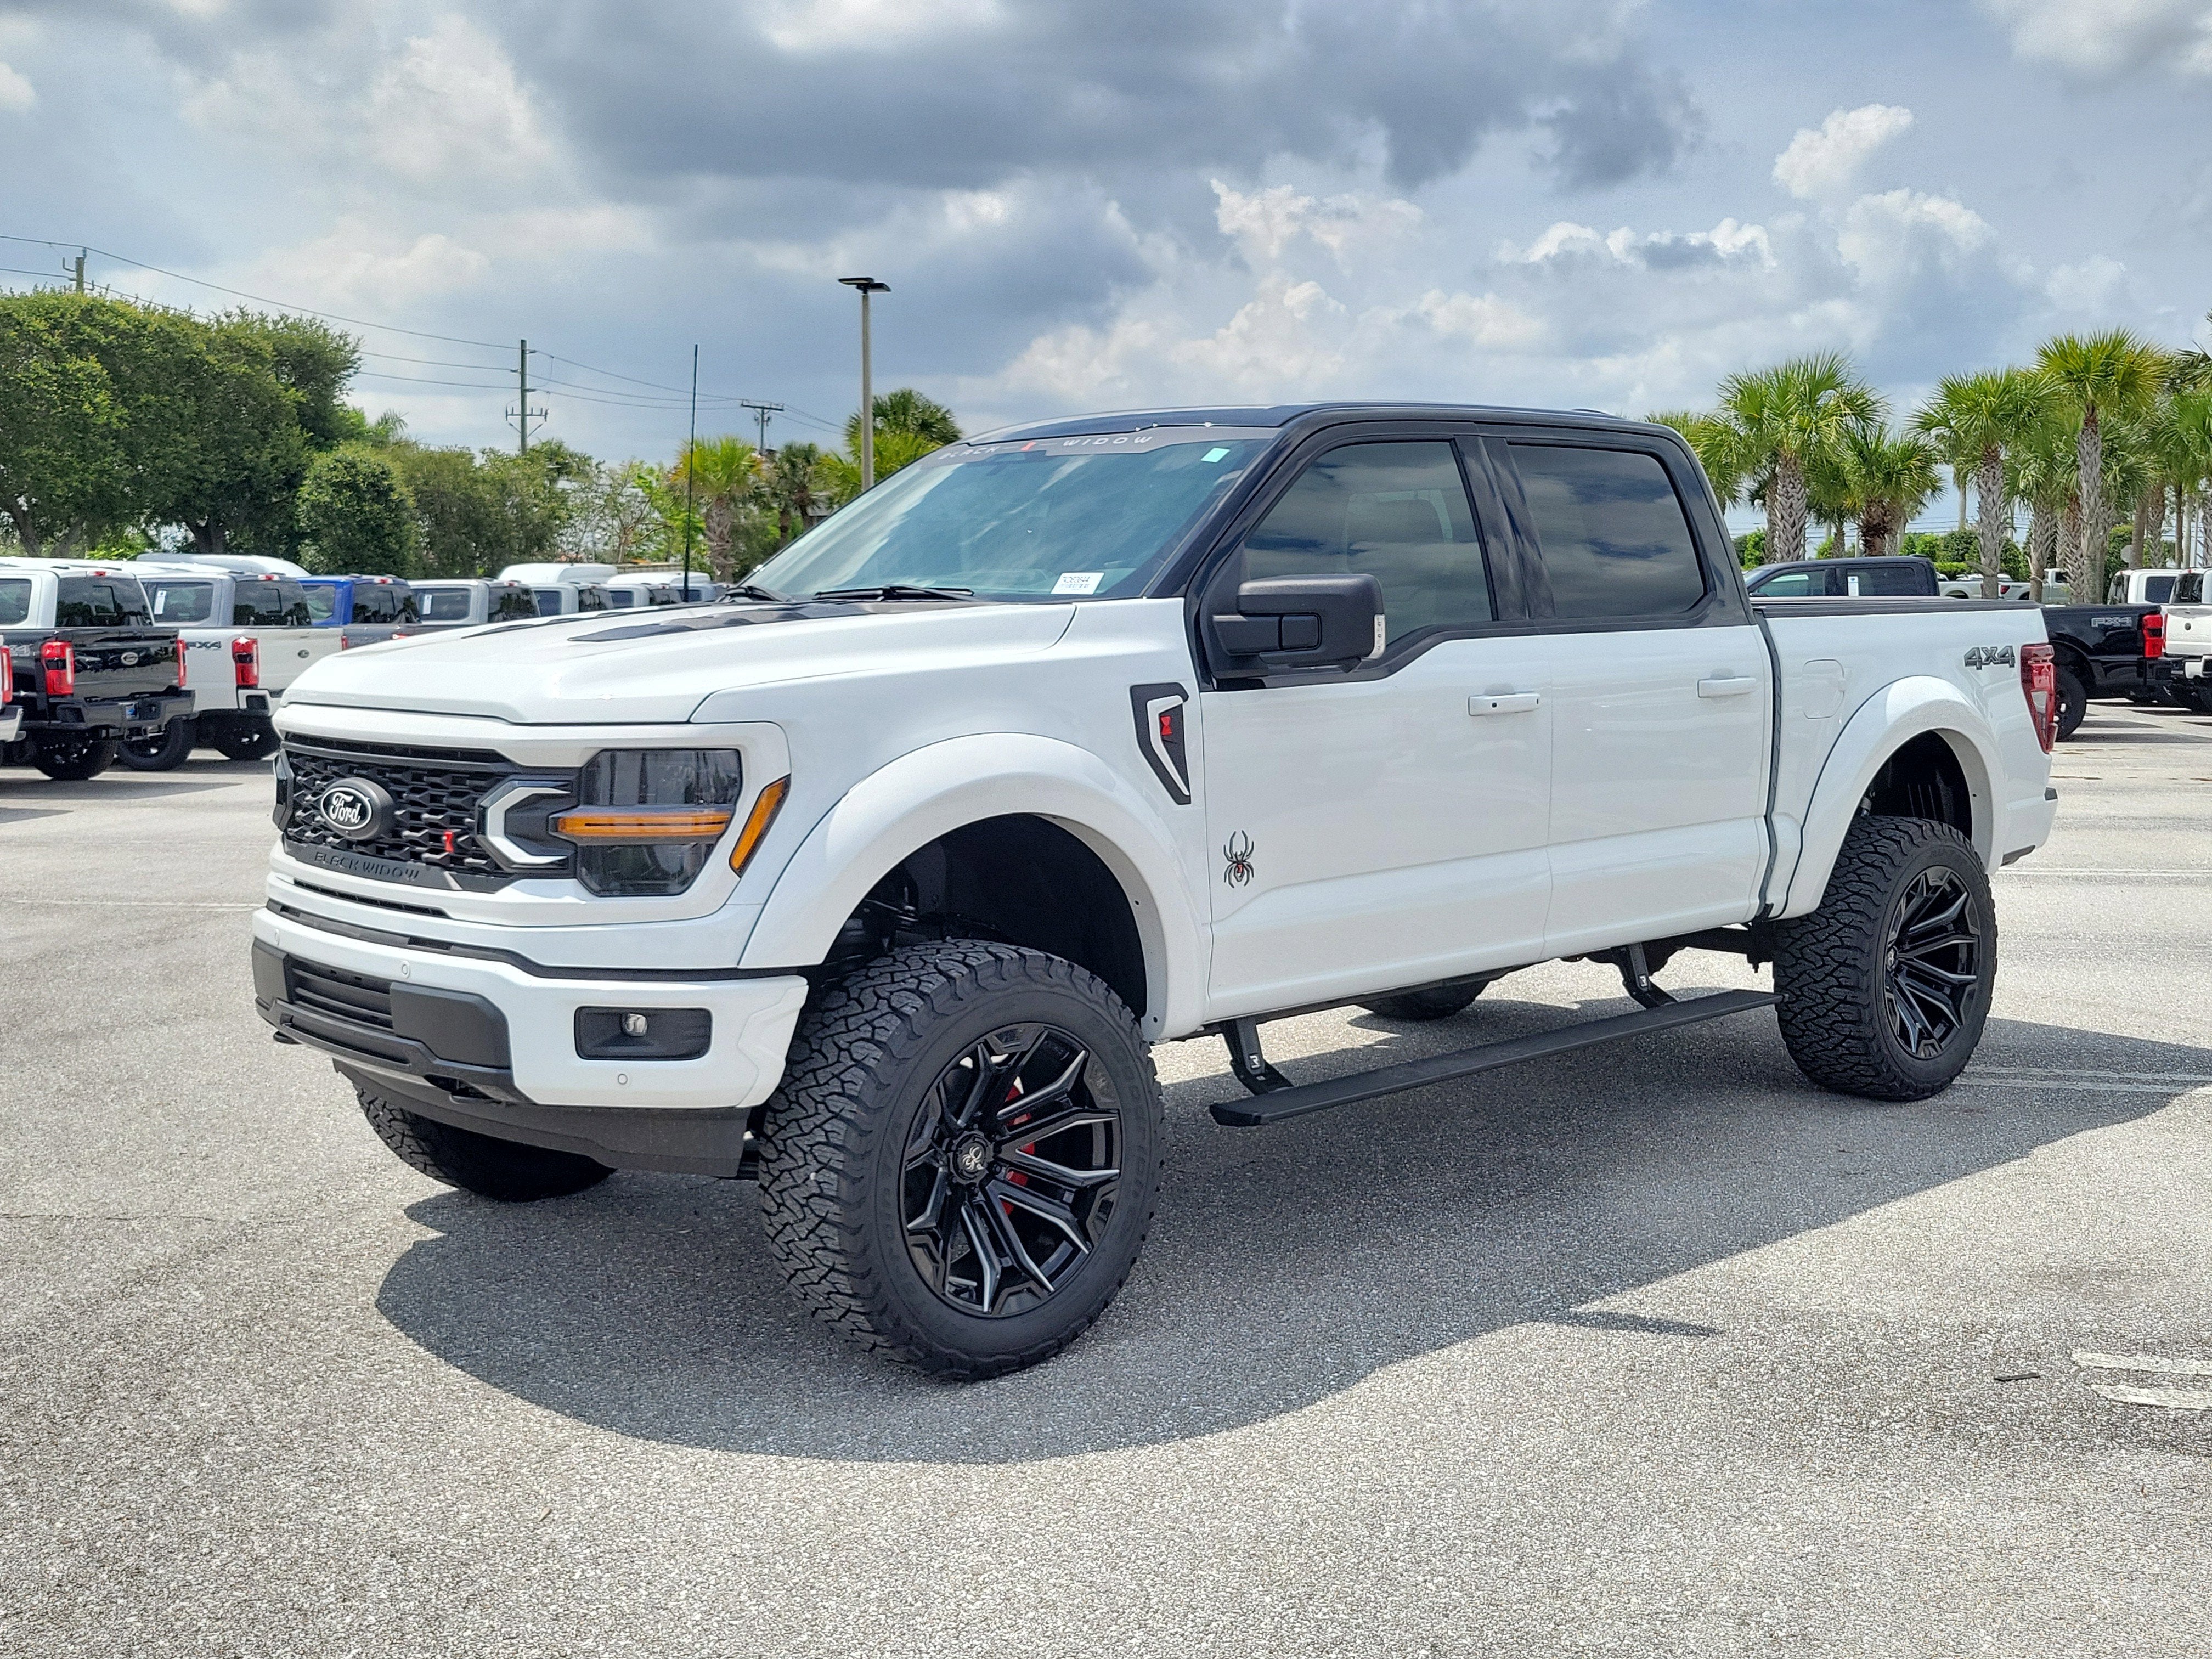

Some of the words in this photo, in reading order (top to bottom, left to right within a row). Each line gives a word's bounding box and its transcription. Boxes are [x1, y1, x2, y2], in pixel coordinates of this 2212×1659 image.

[1063, 436, 1153, 447] WIDOW
[2091, 617, 2132, 627] FX4
[329, 792, 362, 824] Ford
[314, 851, 360, 871] BLACK
[363, 861, 420, 879] WIDOW
